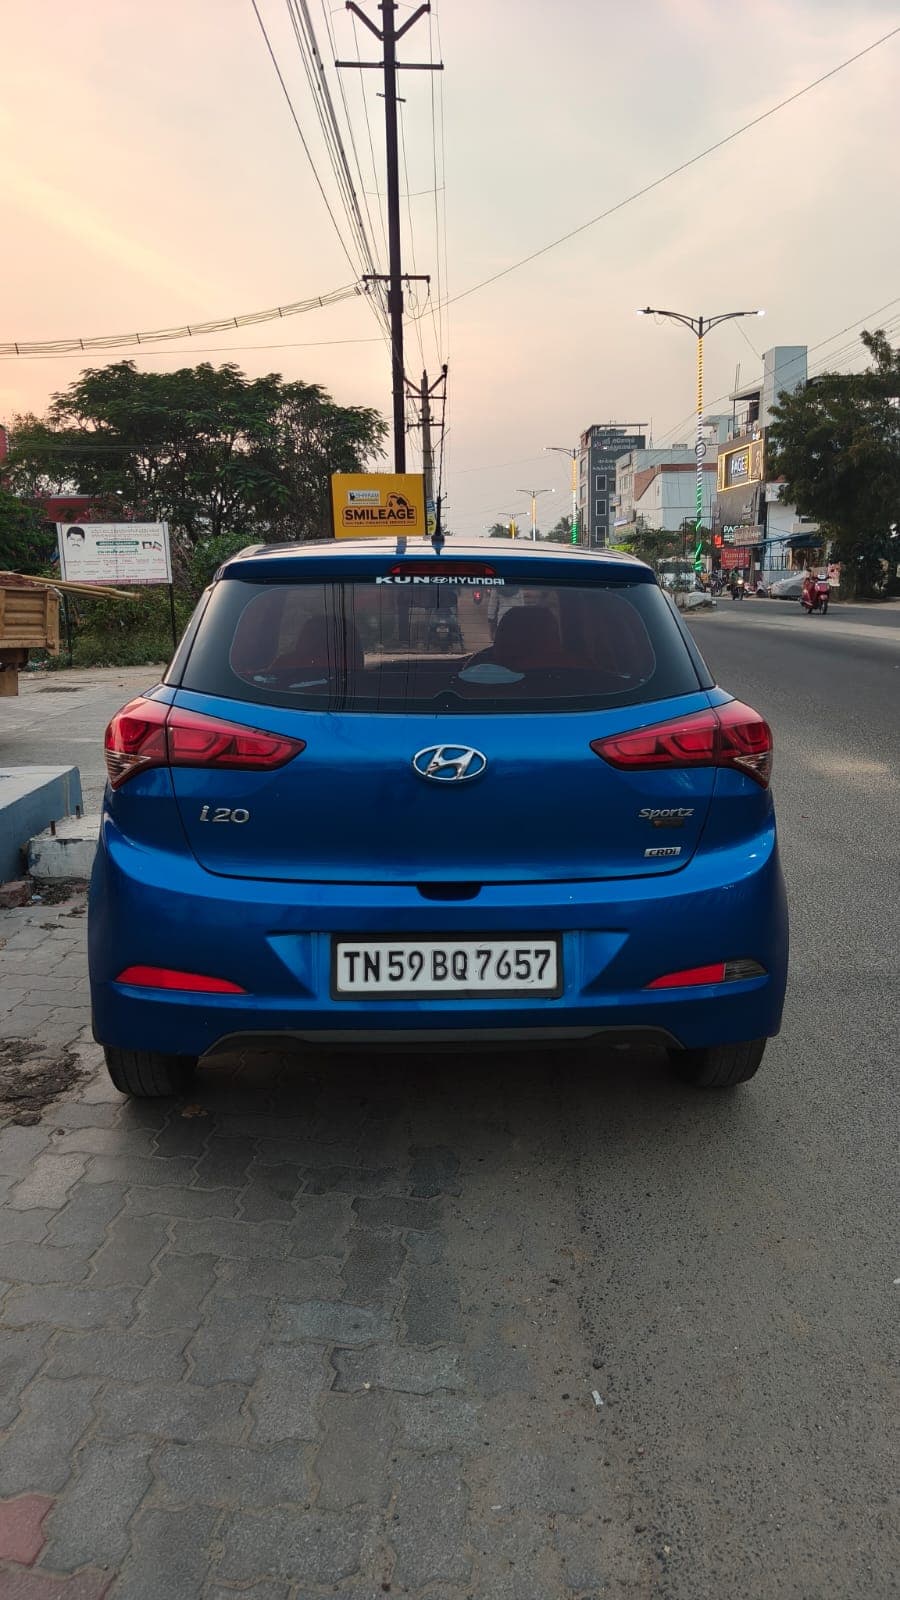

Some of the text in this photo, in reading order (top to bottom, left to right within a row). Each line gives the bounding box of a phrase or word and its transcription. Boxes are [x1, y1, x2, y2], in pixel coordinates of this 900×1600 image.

[345, 509, 415, 520] SMILEAGE
[375, 576, 505, 585] KUN HYUNDAI
[199, 805, 250, 823] i20
[638, 807, 695, 820] Sportz
